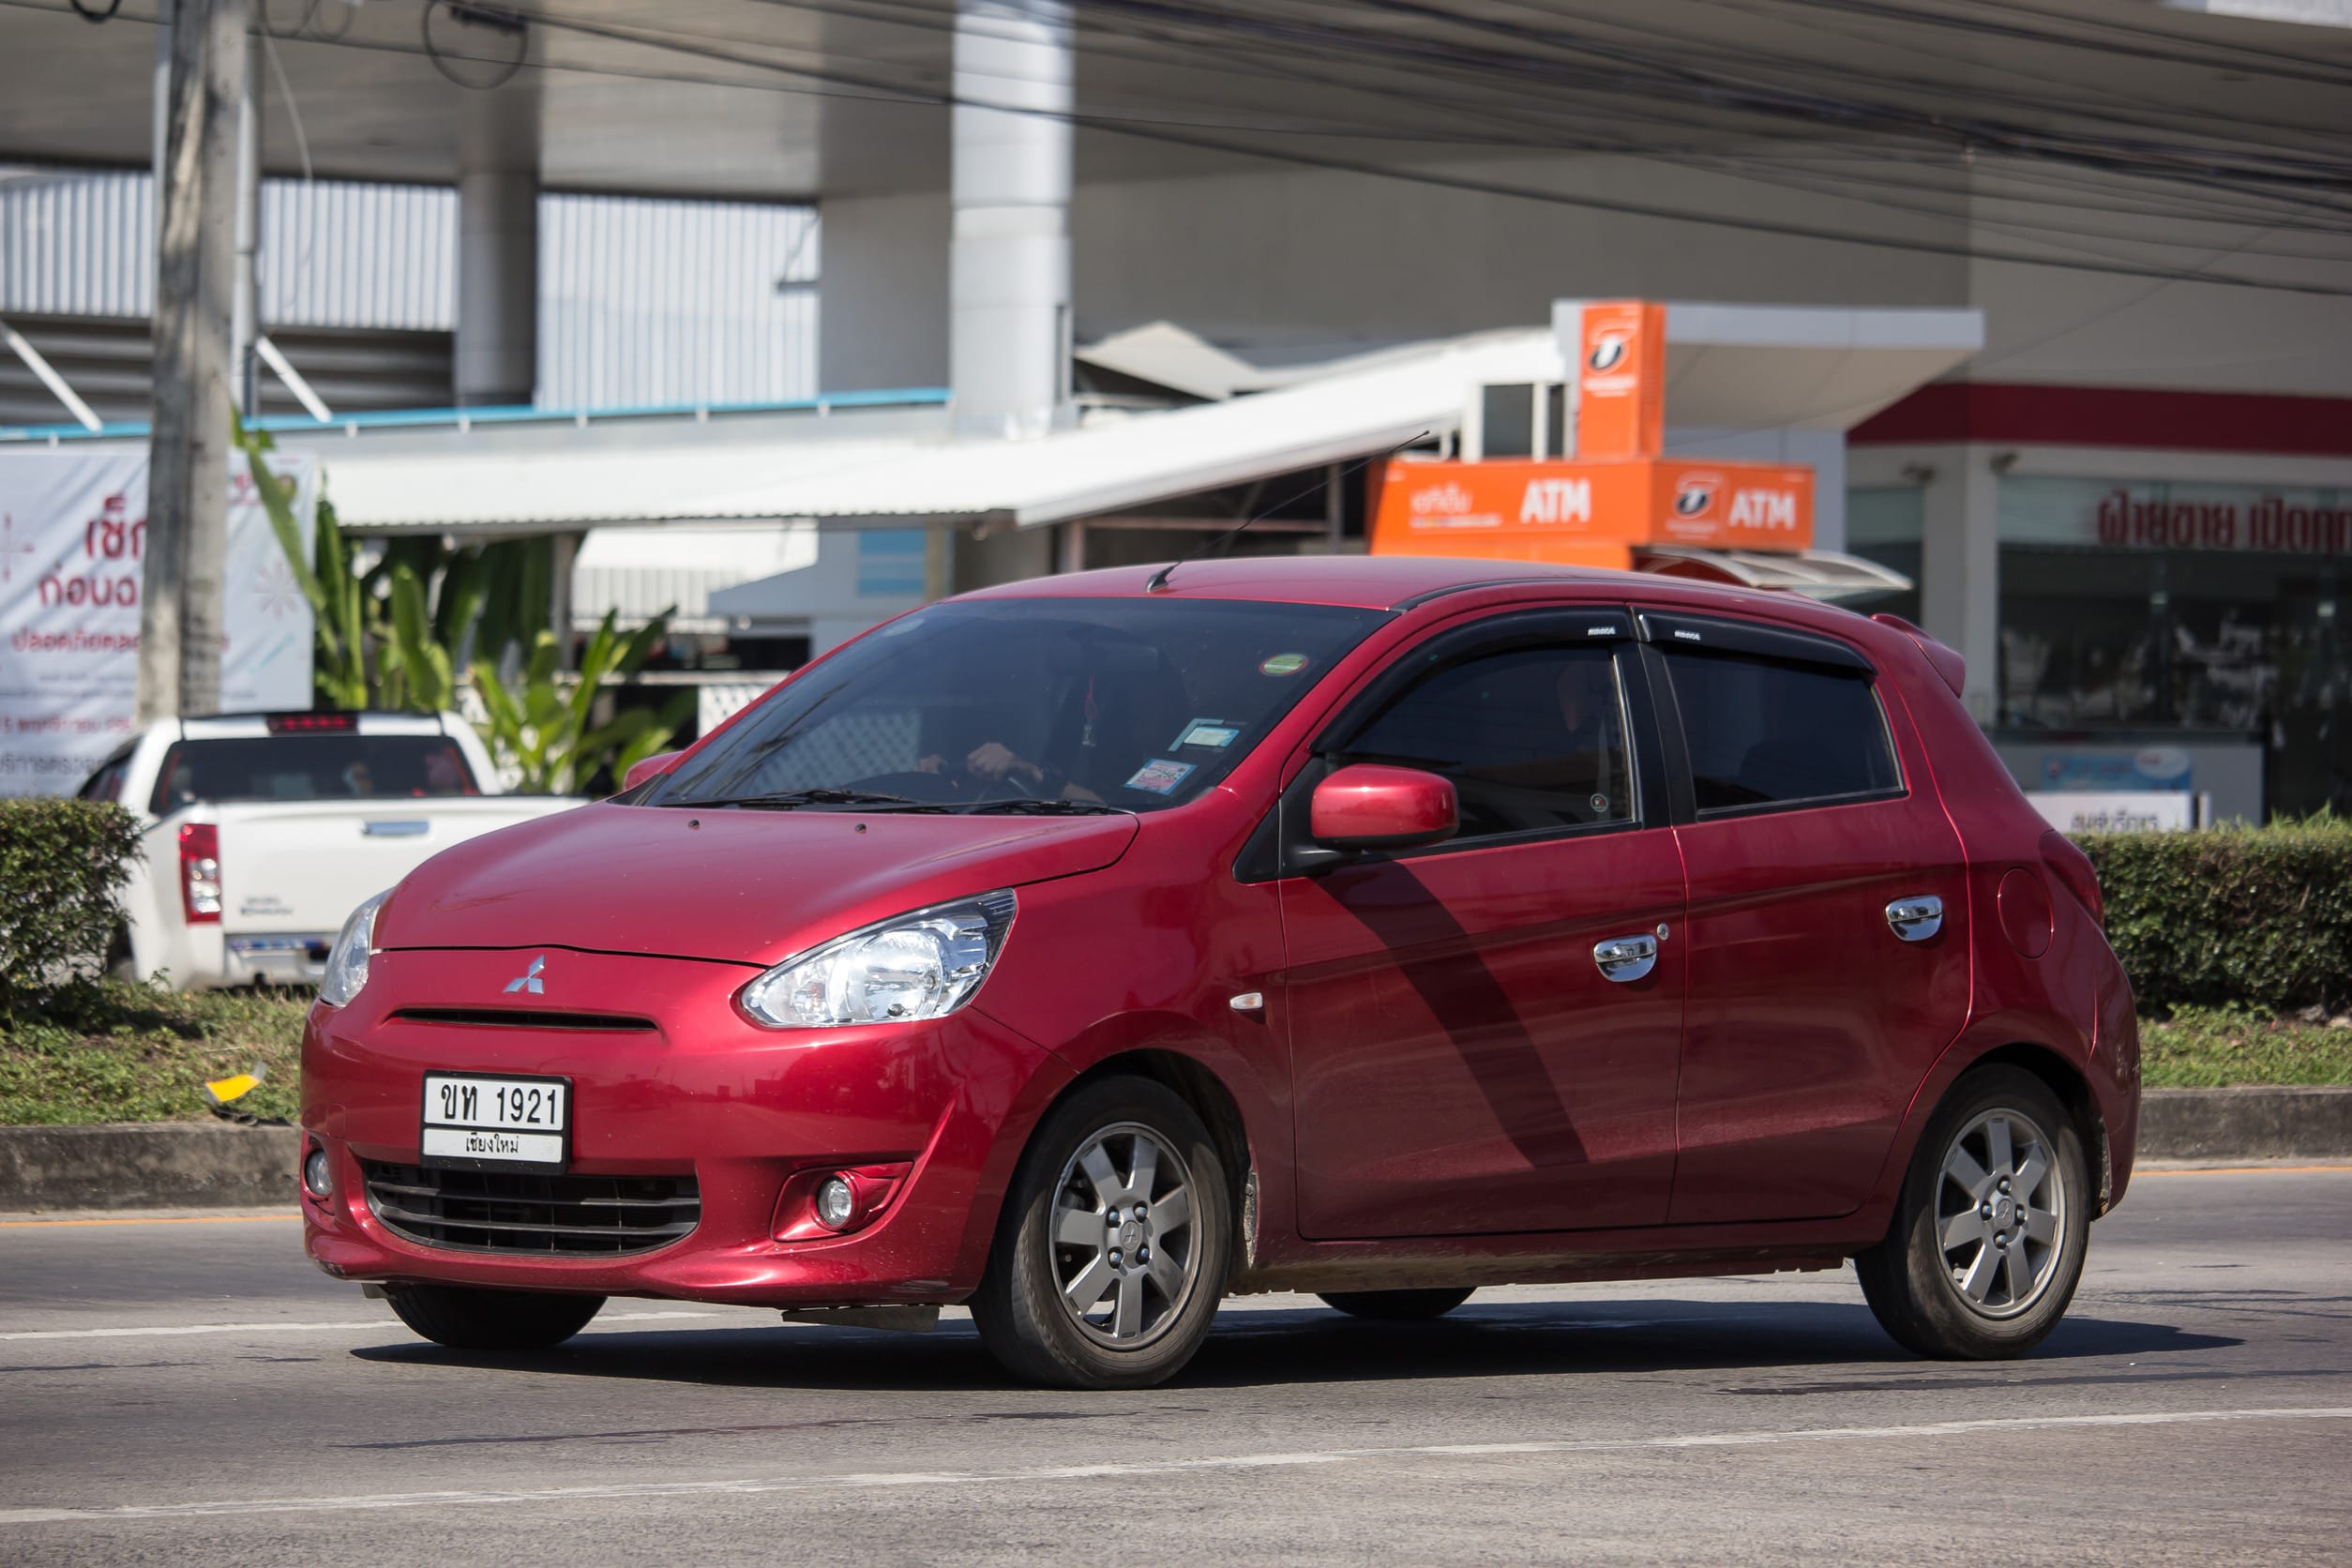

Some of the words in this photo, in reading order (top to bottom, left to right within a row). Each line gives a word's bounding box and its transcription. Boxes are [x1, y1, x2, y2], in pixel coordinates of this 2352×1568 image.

[1519, 478, 1591, 524] ATM
[1728, 488, 1797, 531] ATM
[441, 1084, 478, 1121] ขท
[496, 1086, 556, 1124] 1921
[465, 1131, 520, 1153] เชียงใหม่
